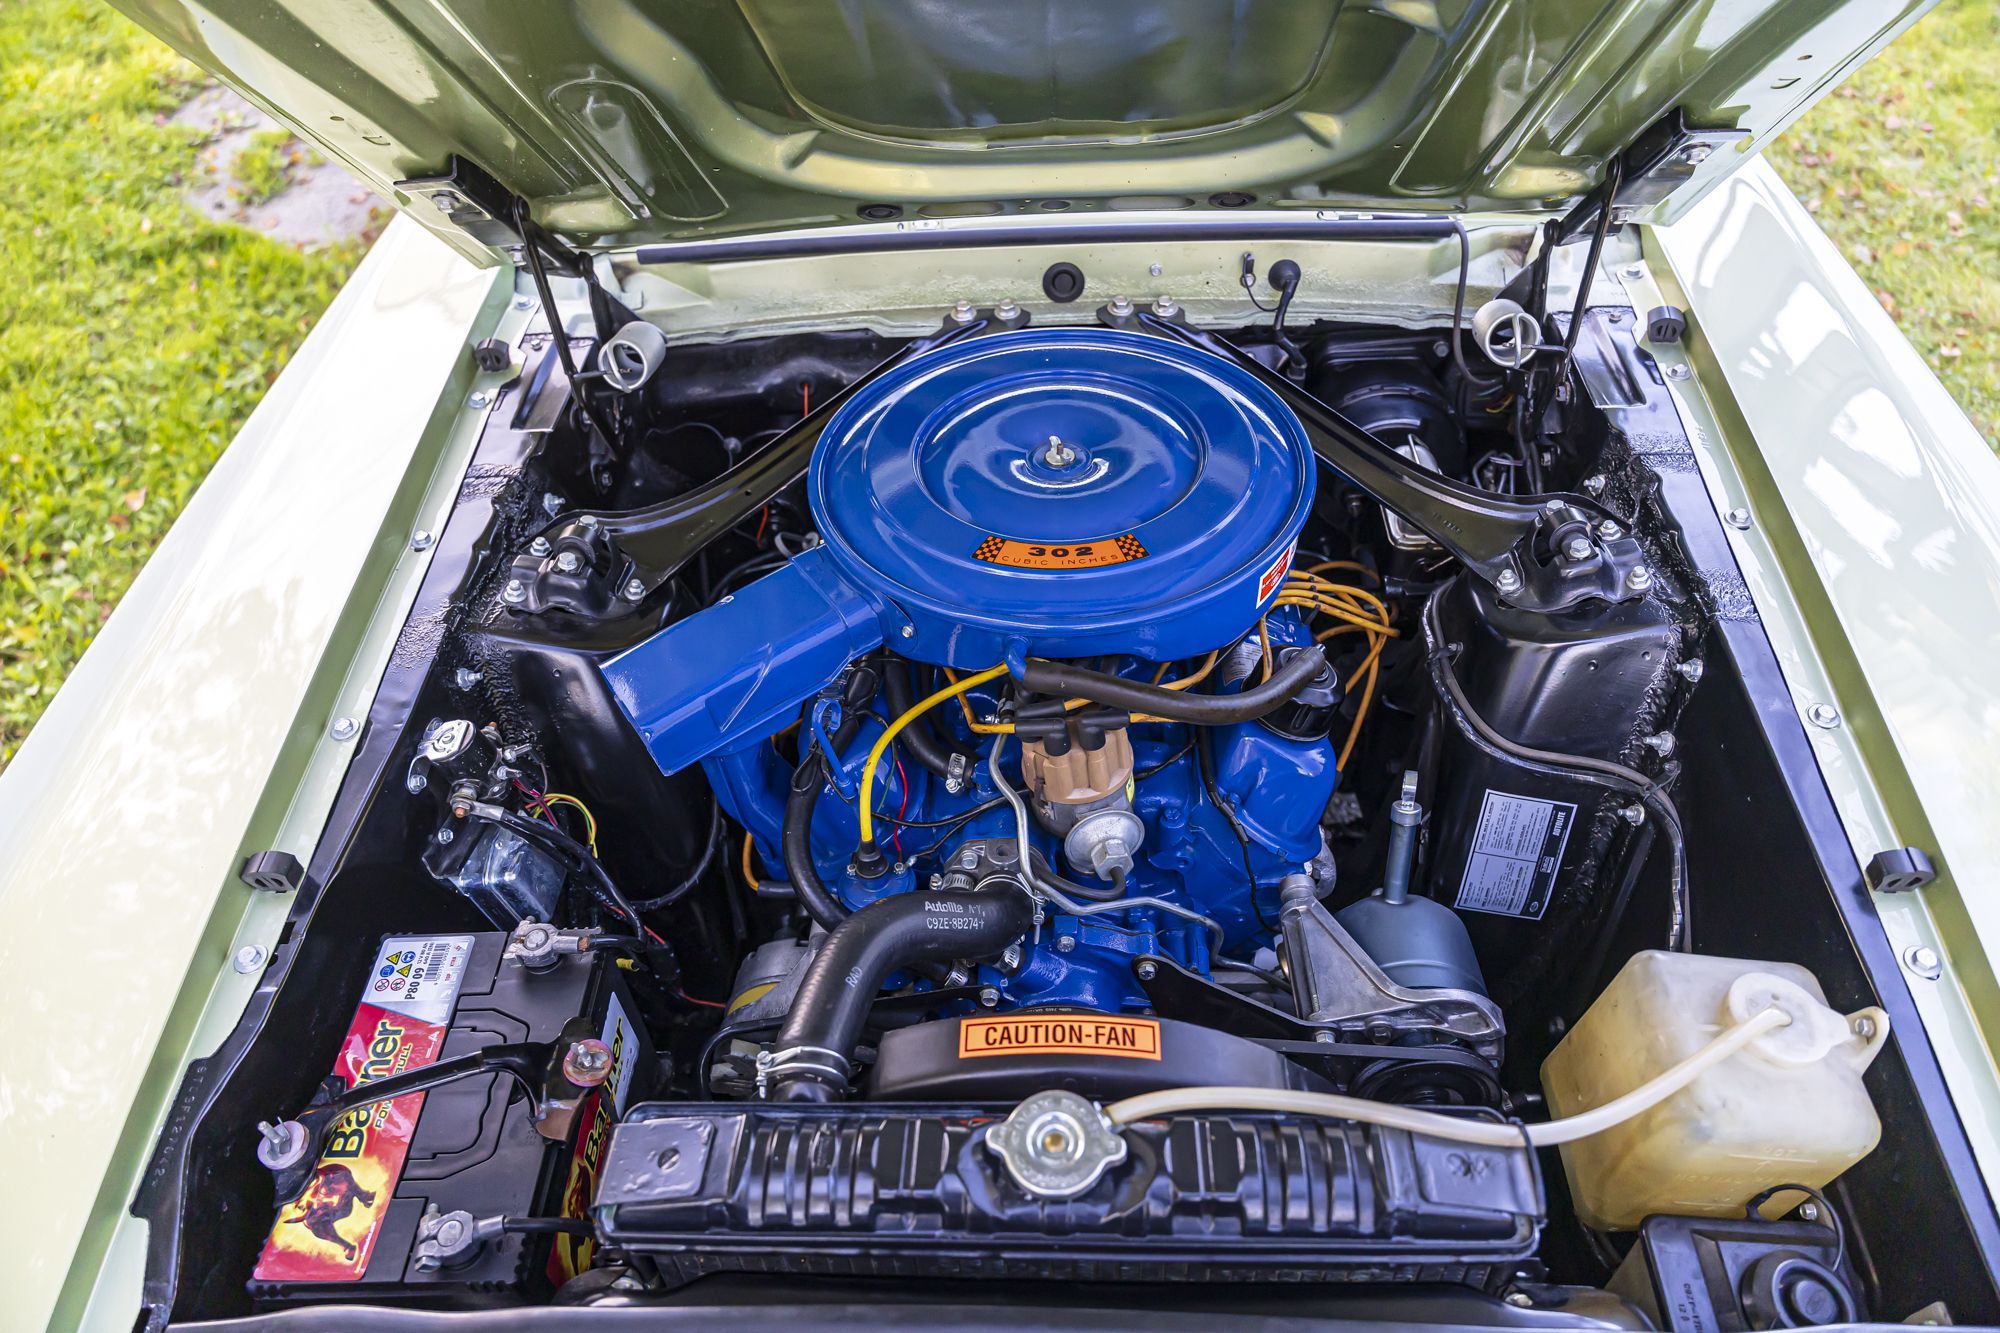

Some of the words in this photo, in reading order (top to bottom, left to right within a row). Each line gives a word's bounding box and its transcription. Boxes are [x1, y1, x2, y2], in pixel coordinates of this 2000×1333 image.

[1002, 555, 1049, 566] CUBIC
[1061, 554, 1119, 566] INCHES
[1028, 546, 1094, 558] 302
[1552, 811, 1566, 837] AUTOLITE
[924, 900, 964, 914] Autolite
[404, 981, 420, 1000] P80
[412, 967, 425, 980] 09
[845, 966, 863, 988] RAD
[984, 1024, 1137, 1047] CAUTION-FAN
[395, 1043, 413, 1074] BULL
[323, 1020, 404, 1158] Baner
[585, 1016, 624, 1173] Baner
